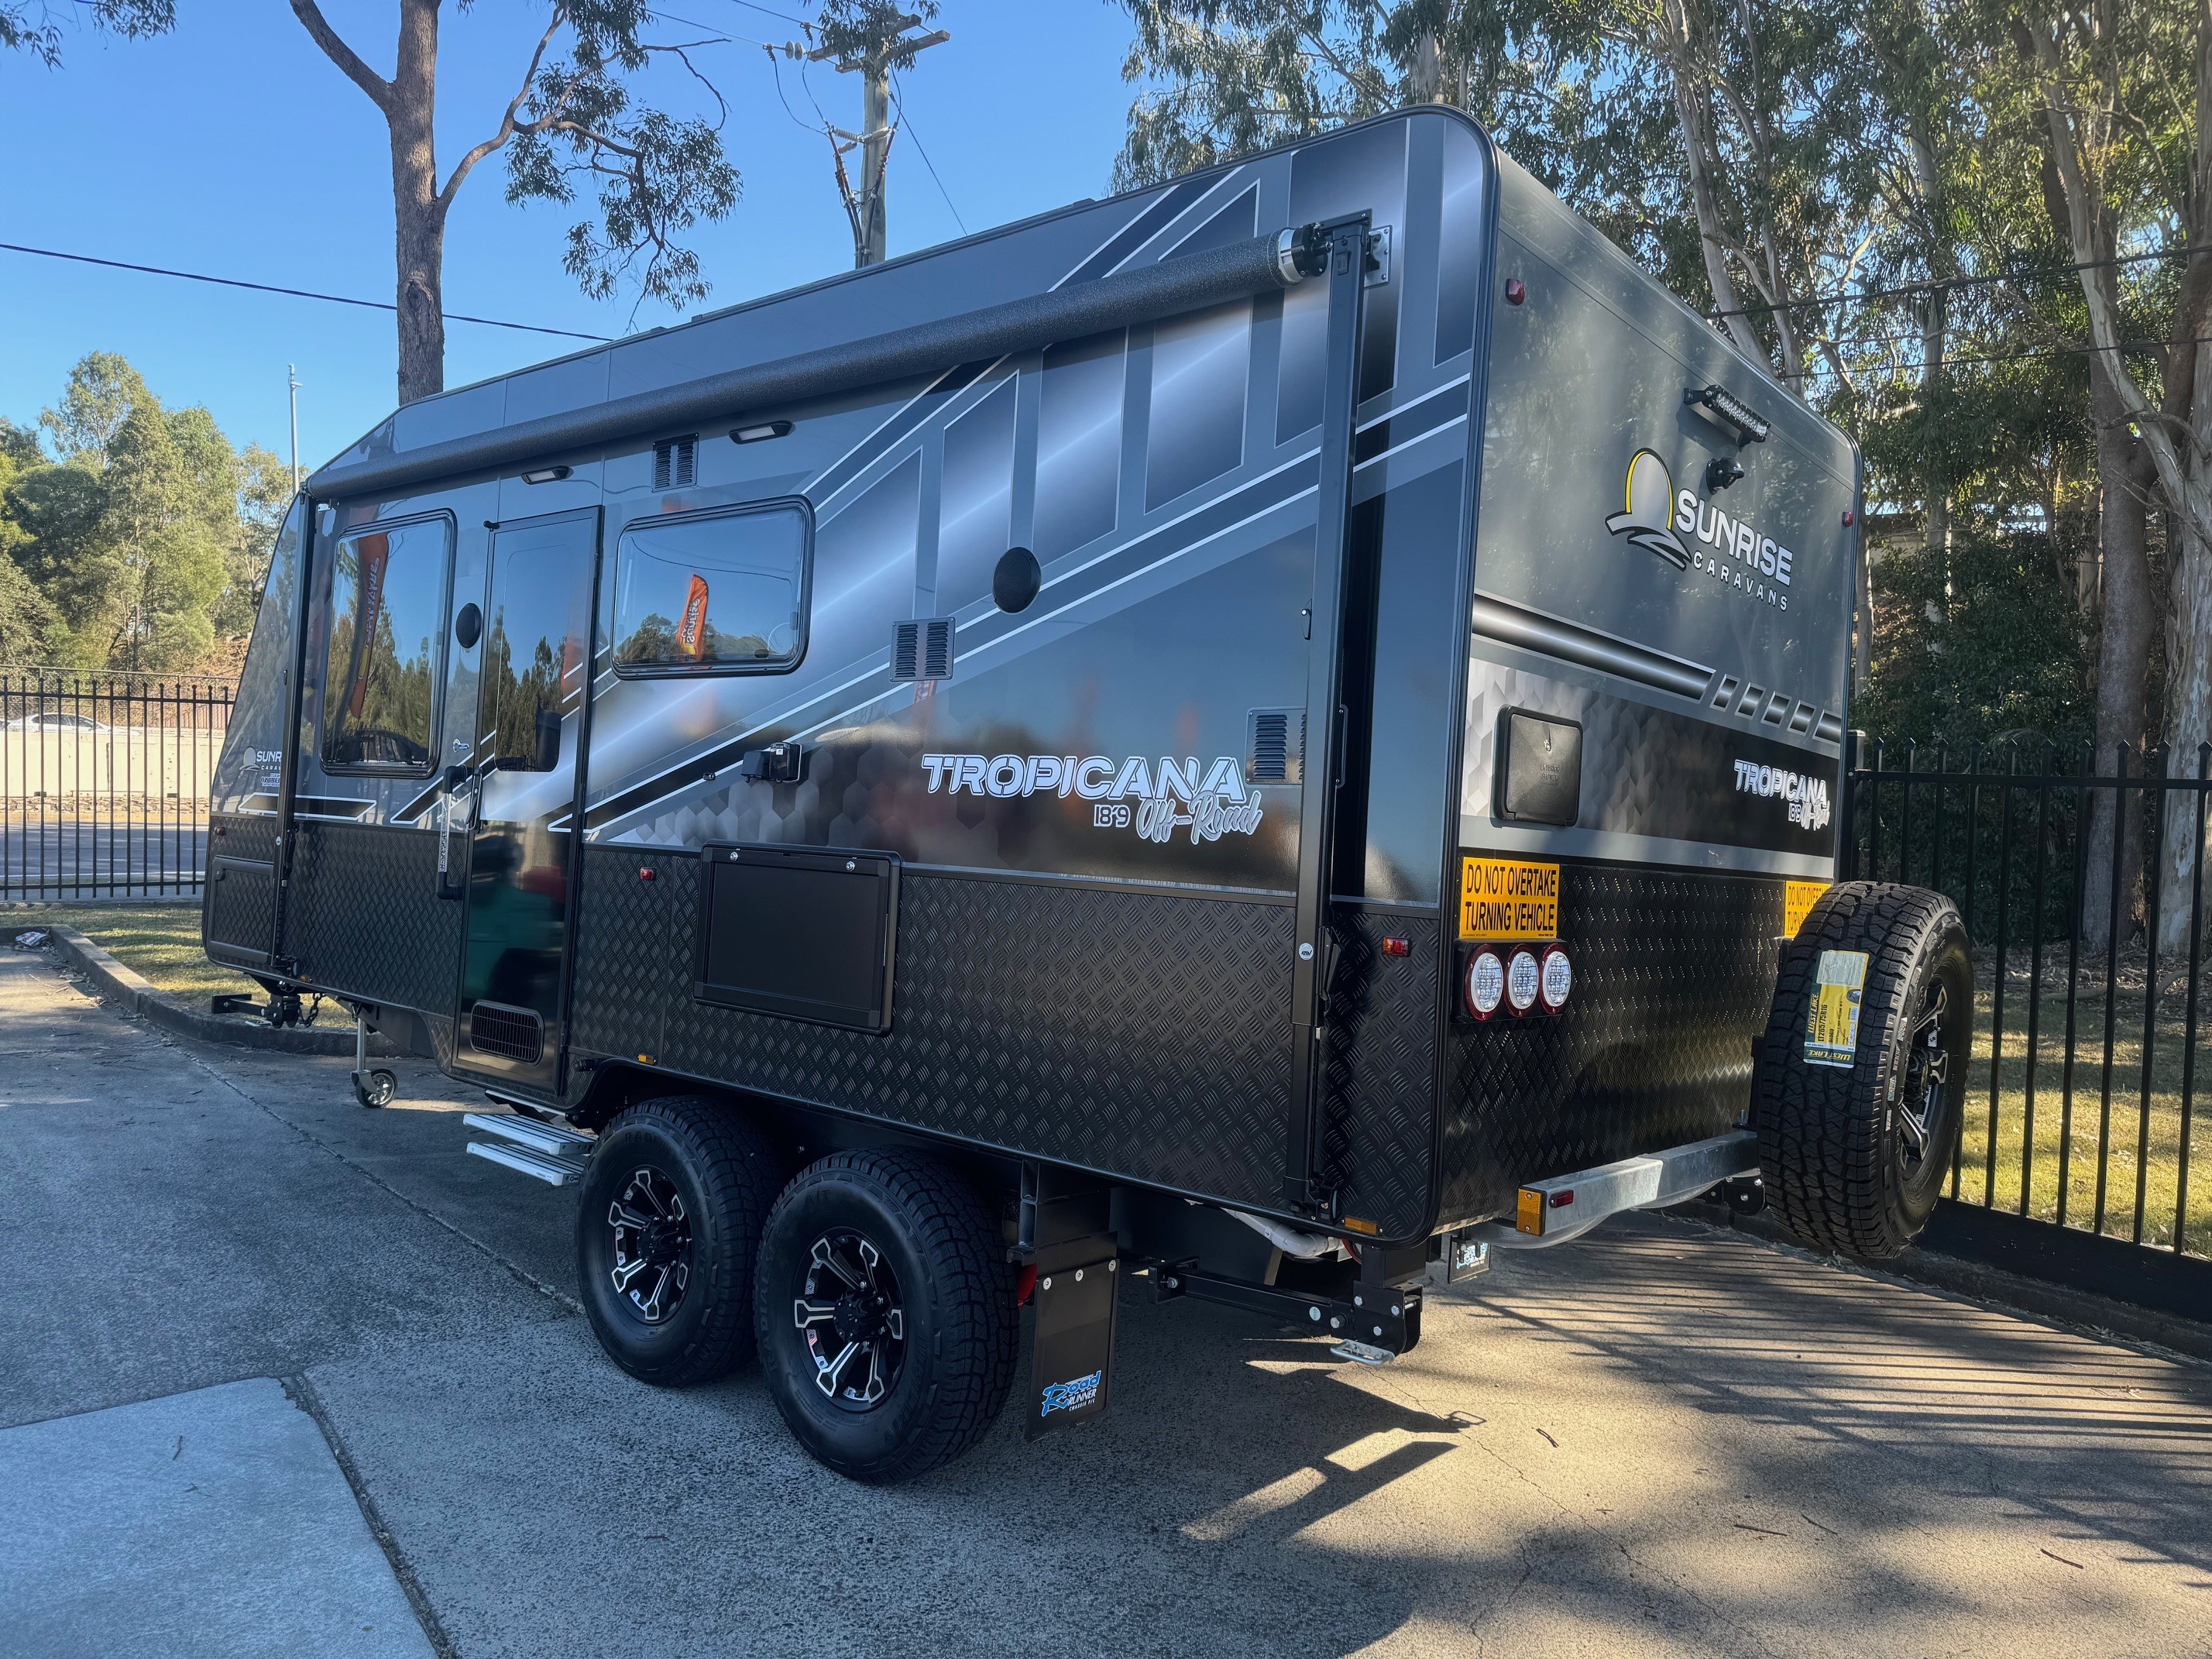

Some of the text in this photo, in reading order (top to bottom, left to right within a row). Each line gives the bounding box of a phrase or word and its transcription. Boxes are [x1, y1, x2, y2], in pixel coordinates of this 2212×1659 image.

[1675, 488, 1793, 586] SUNRISE
[1693, 551, 1788, 611] CARAVANS
[921, 754, 1247, 802] TROPICANA
[1734, 759, 1827, 808] TROPICANA
[1136, 789, 1263, 845] Off-Road
[1466, 864, 1557, 897] DO NOT OVERTAKE
[1788, 886, 1795, 905] DO
[1796, 887, 1806, 906] NOT
[1465, 902, 1555, 931] TURNING VEHICLE
[1042, 1370, 1101, 1417] Road
[1068, 1389, 1097, 1406] RUNNER
[1069, 1401, 1087, 1412] CHASSIS
